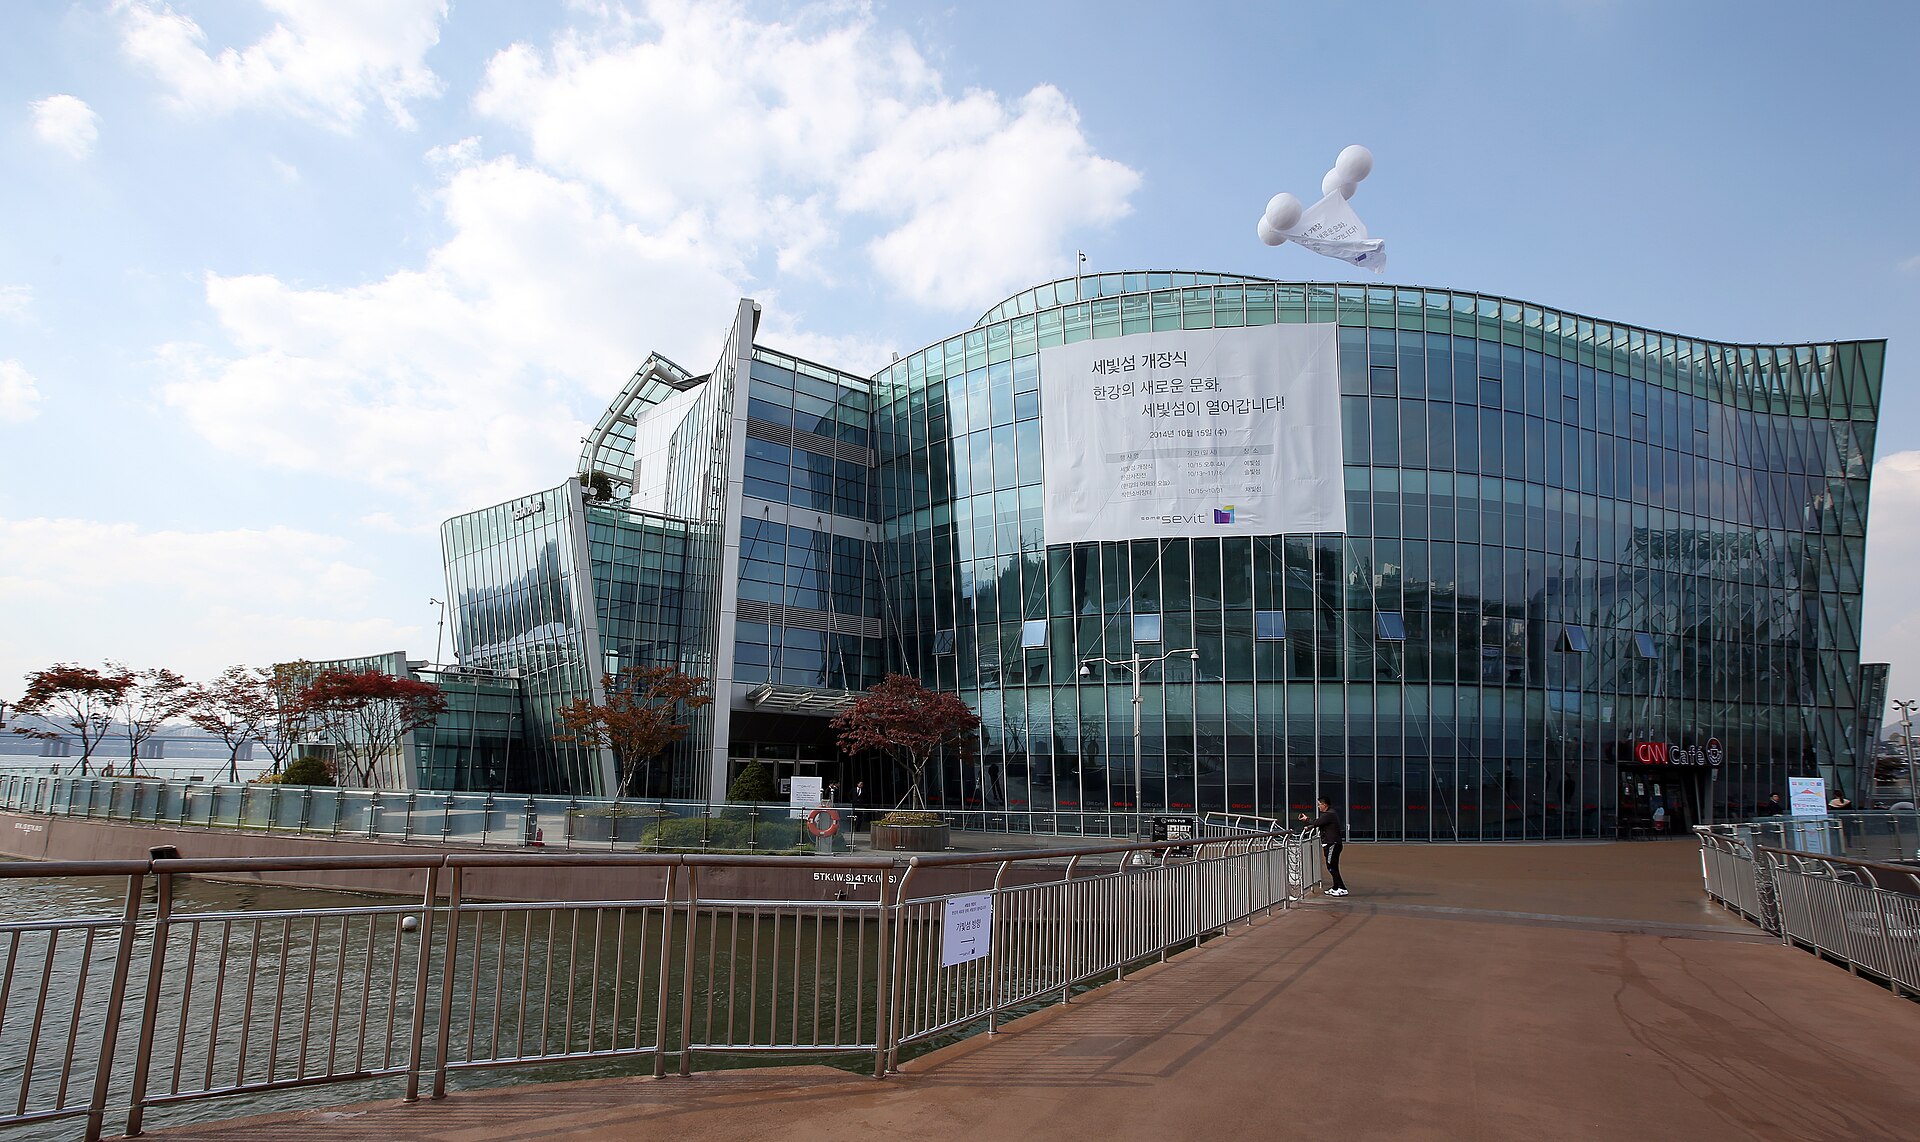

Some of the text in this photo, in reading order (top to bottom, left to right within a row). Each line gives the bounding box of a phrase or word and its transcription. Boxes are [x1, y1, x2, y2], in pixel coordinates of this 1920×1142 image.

[1091, 350, 1188, 376] 세빛섬 개장식
[1093, 377, 1222, 401] 한강의 새로운 문화,
[1141, 395, 1286, 418] 세빛섬이 열어갑니다!
[1149, 428, 1228, 439] 2014년 10월 15일 (수)
[1161, 513, 1205, 524] sevit
[1636, 742, 1705, 765] CNN Café
